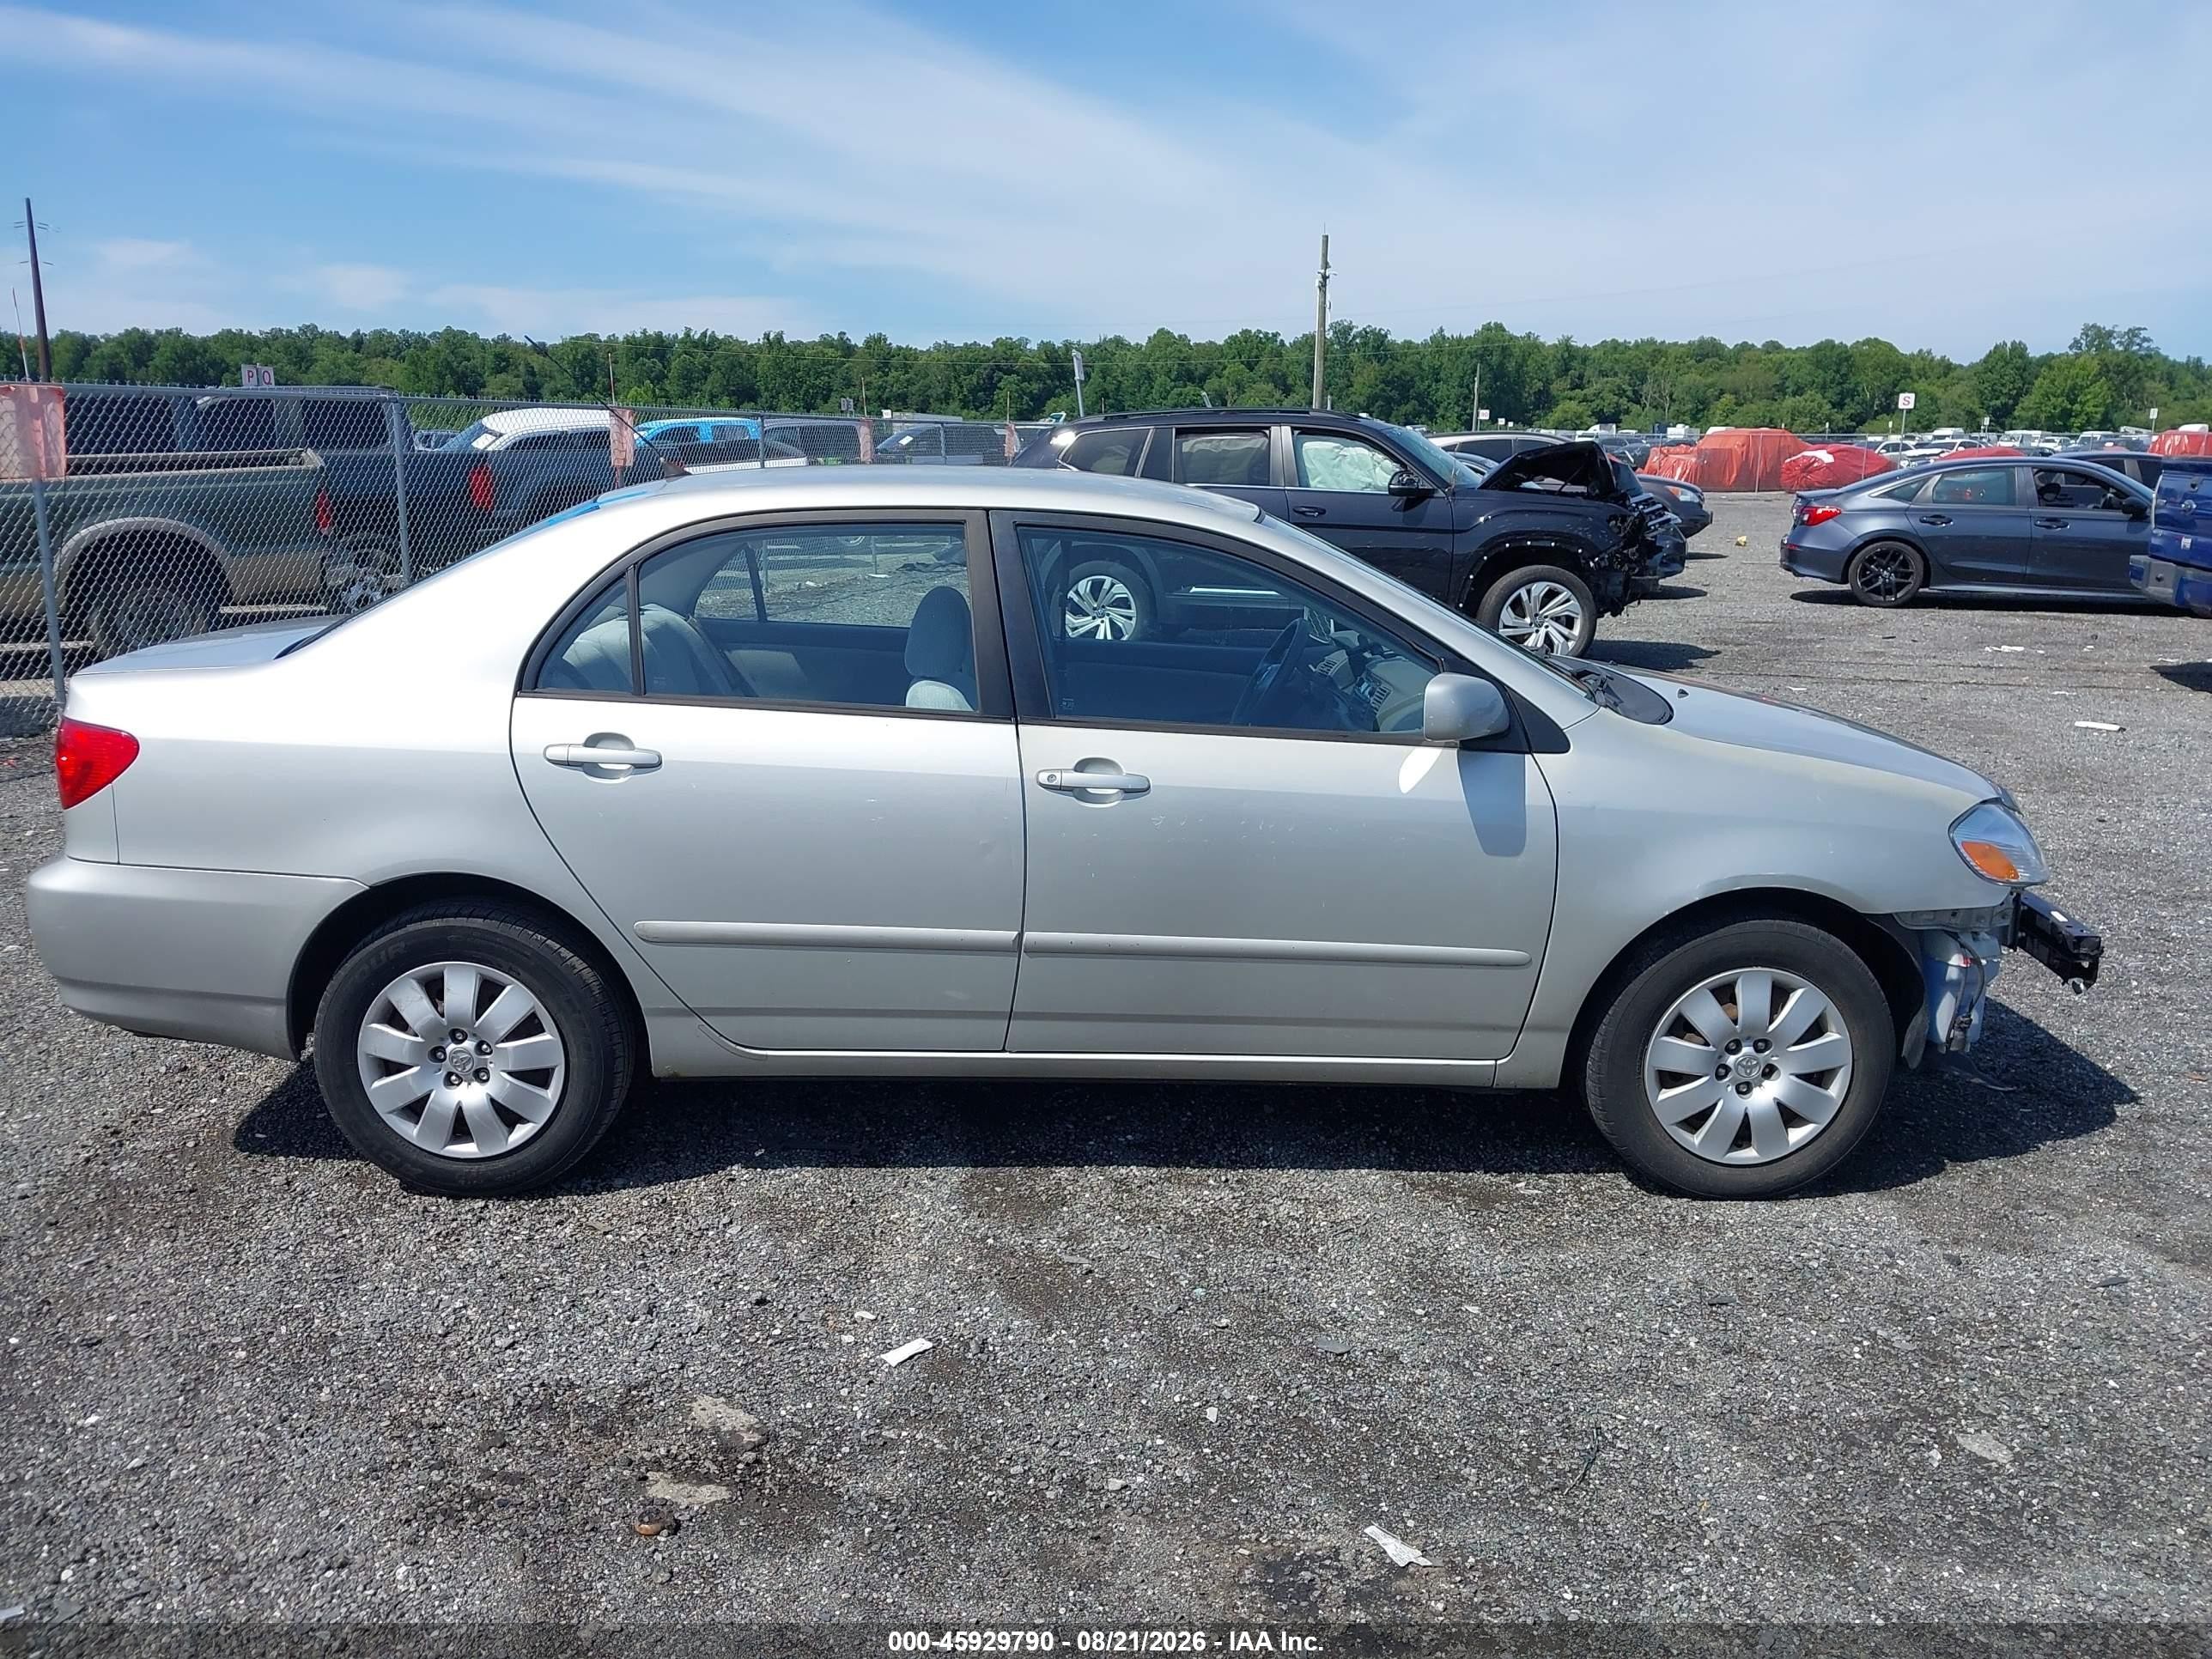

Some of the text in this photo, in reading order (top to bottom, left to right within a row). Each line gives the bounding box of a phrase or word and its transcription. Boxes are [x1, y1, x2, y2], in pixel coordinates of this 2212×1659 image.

[247, 370, 253, 383] P
[263, 370, 272, 385] Q
[1902, 396, 1911, 406] S
